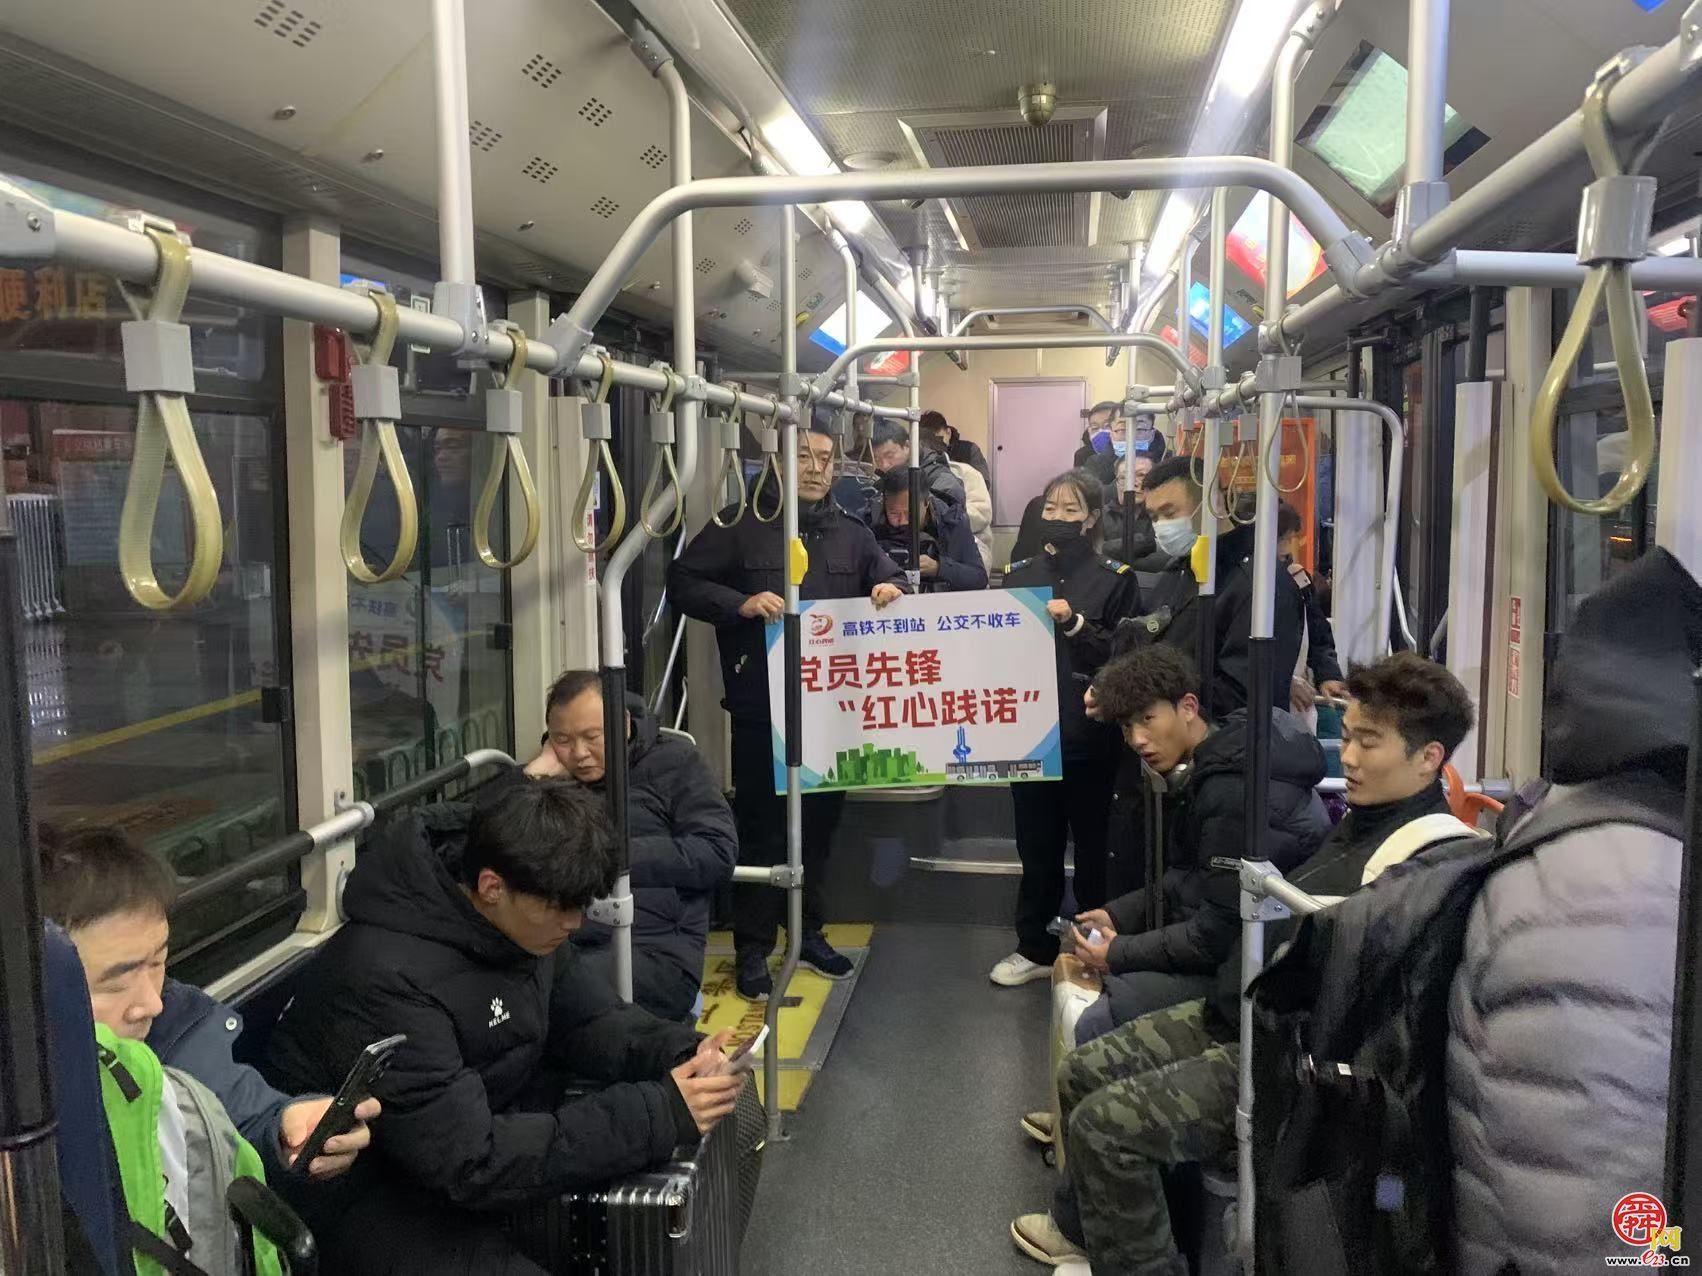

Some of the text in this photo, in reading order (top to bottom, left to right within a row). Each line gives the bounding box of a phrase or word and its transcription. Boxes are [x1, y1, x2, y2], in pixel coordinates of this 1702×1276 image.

[842, 612, 1021, 637] 高铁不到站 公交不收车
[800, 649, 942, 692] 党员先锋
